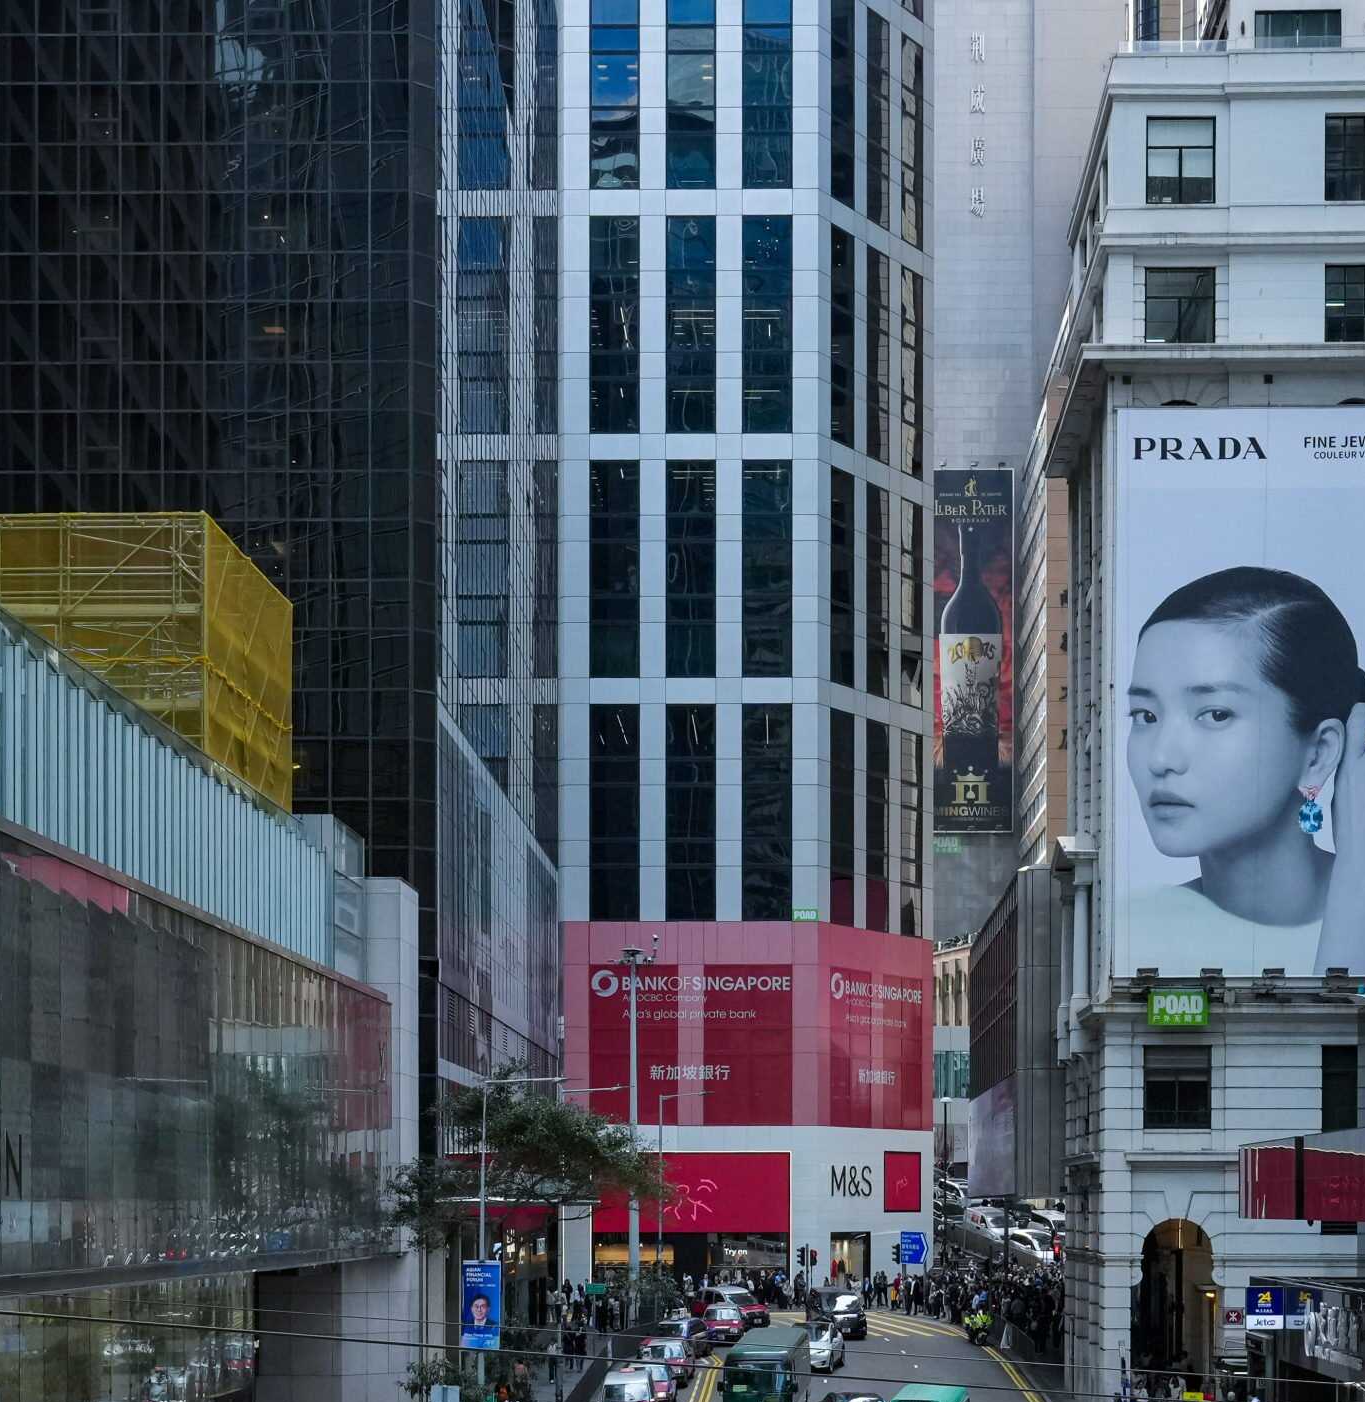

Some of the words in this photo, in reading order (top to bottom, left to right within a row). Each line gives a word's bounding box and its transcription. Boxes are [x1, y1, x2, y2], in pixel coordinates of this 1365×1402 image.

[1133, 437, 1268, 460] PRADA
[1304, 435, 1336, 448] FINE
[1314, 450, 1357, 460] COULEUR
[971, 500, 1008, 515] PATER
[1153, 995, 1204, 1014] POAD
[654, 1008, 686, 1020] global
[689, 1008, 727, 1020] private
[729, 1008, 756, 1019] bank
[649, 1065, 731, 1081] 新加坡銀行
[830, 1165, 873, 1197] M&S
[1257, 1291, 1272, 1304] 24
